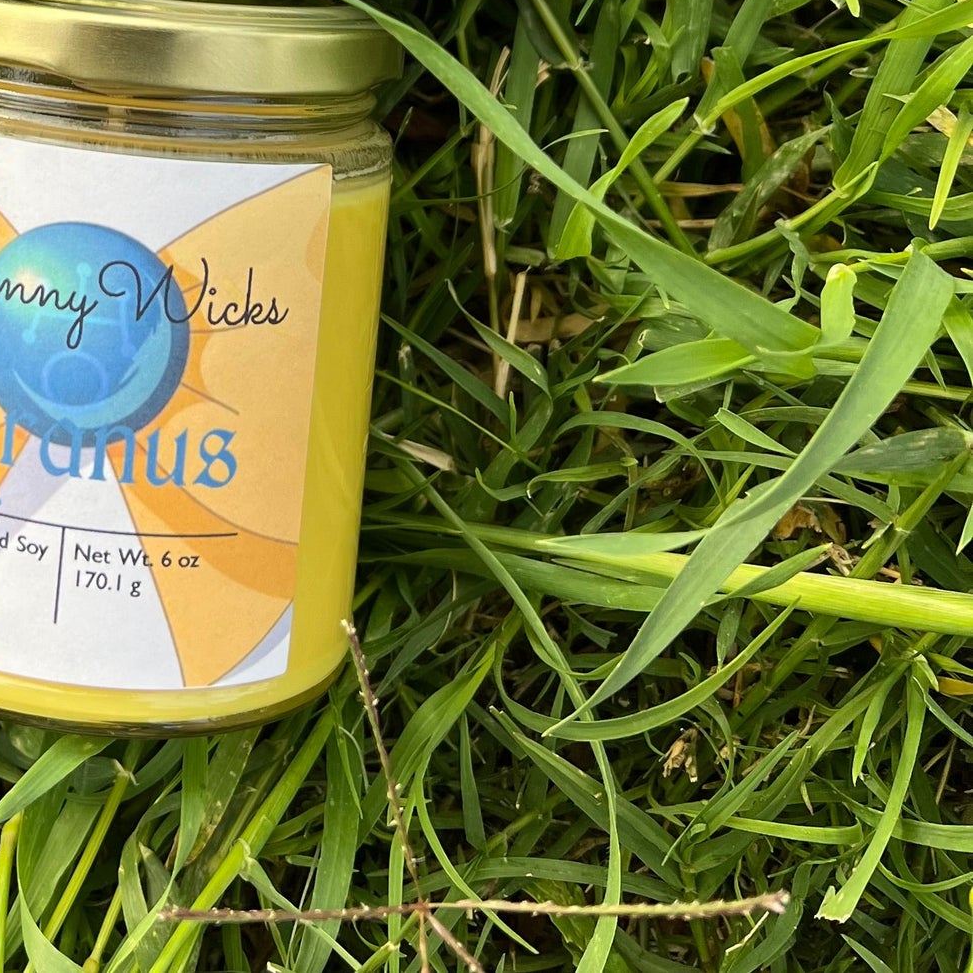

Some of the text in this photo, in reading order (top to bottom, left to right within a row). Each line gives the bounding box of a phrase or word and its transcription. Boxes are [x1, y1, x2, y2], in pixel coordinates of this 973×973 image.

[98, 257, 289, 326] Wicks
[16, 535, 49, 560] Soy
[74, 544, 201, 569] Net Wt. 6 oz
[75, 569, 142, 597] 170.1 g
